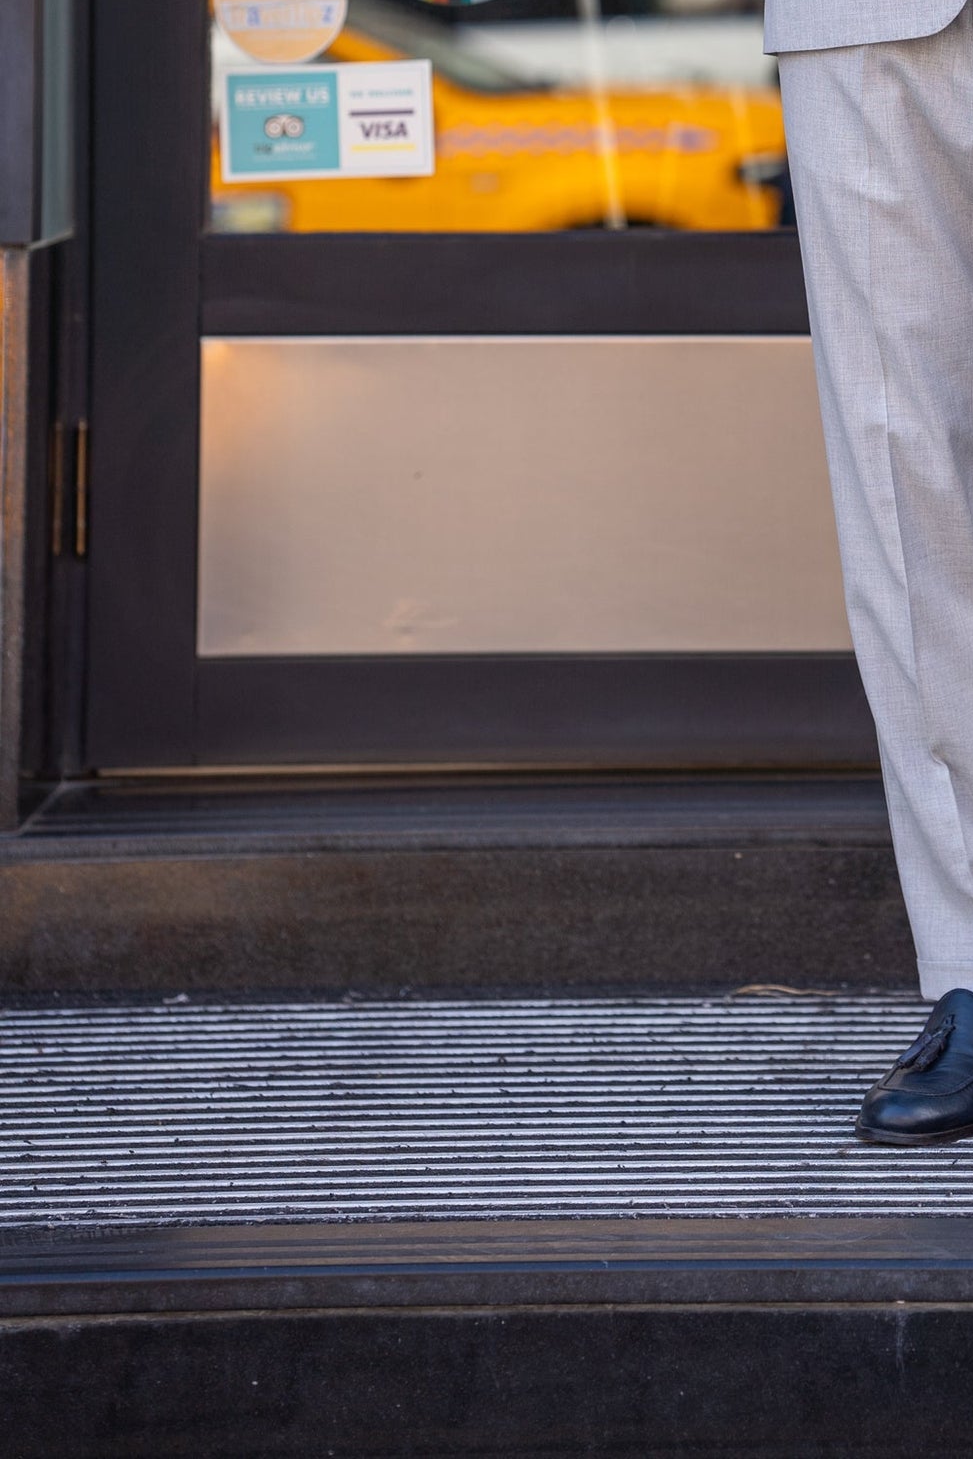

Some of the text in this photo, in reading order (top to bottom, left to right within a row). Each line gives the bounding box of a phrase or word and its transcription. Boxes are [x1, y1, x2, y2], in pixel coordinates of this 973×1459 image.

[234, 87, 302, 107] REVIEW
[305, 85, 330, 103] US
[360, 120, 408, 139] VISA
